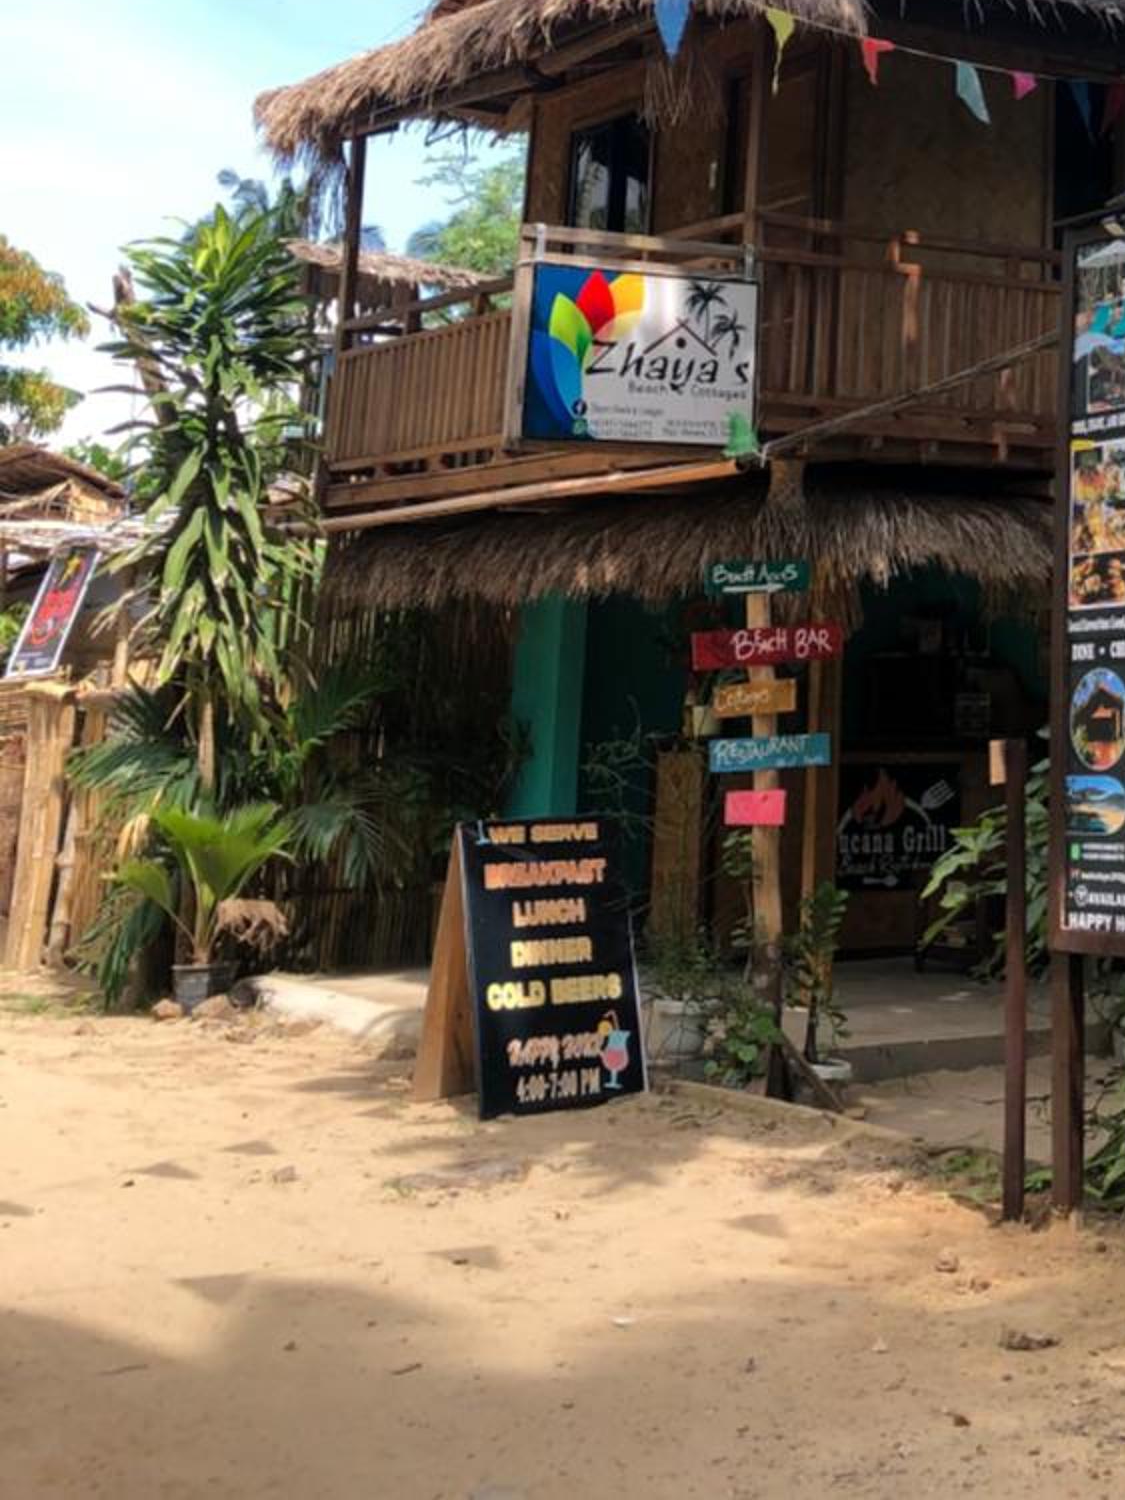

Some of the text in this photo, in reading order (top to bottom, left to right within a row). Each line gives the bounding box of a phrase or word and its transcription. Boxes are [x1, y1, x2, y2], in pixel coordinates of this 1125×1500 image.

[586, 338, 749, 391] Zhaya's
[488, 825, 526, 844] WE
[484, 858, 607, 890] BREAKFAST
[512, 897, 587, 928] LUNCH
[1068, 911, 1112, 932] HAPPY
[486, 979, 546, 1011] COLD
